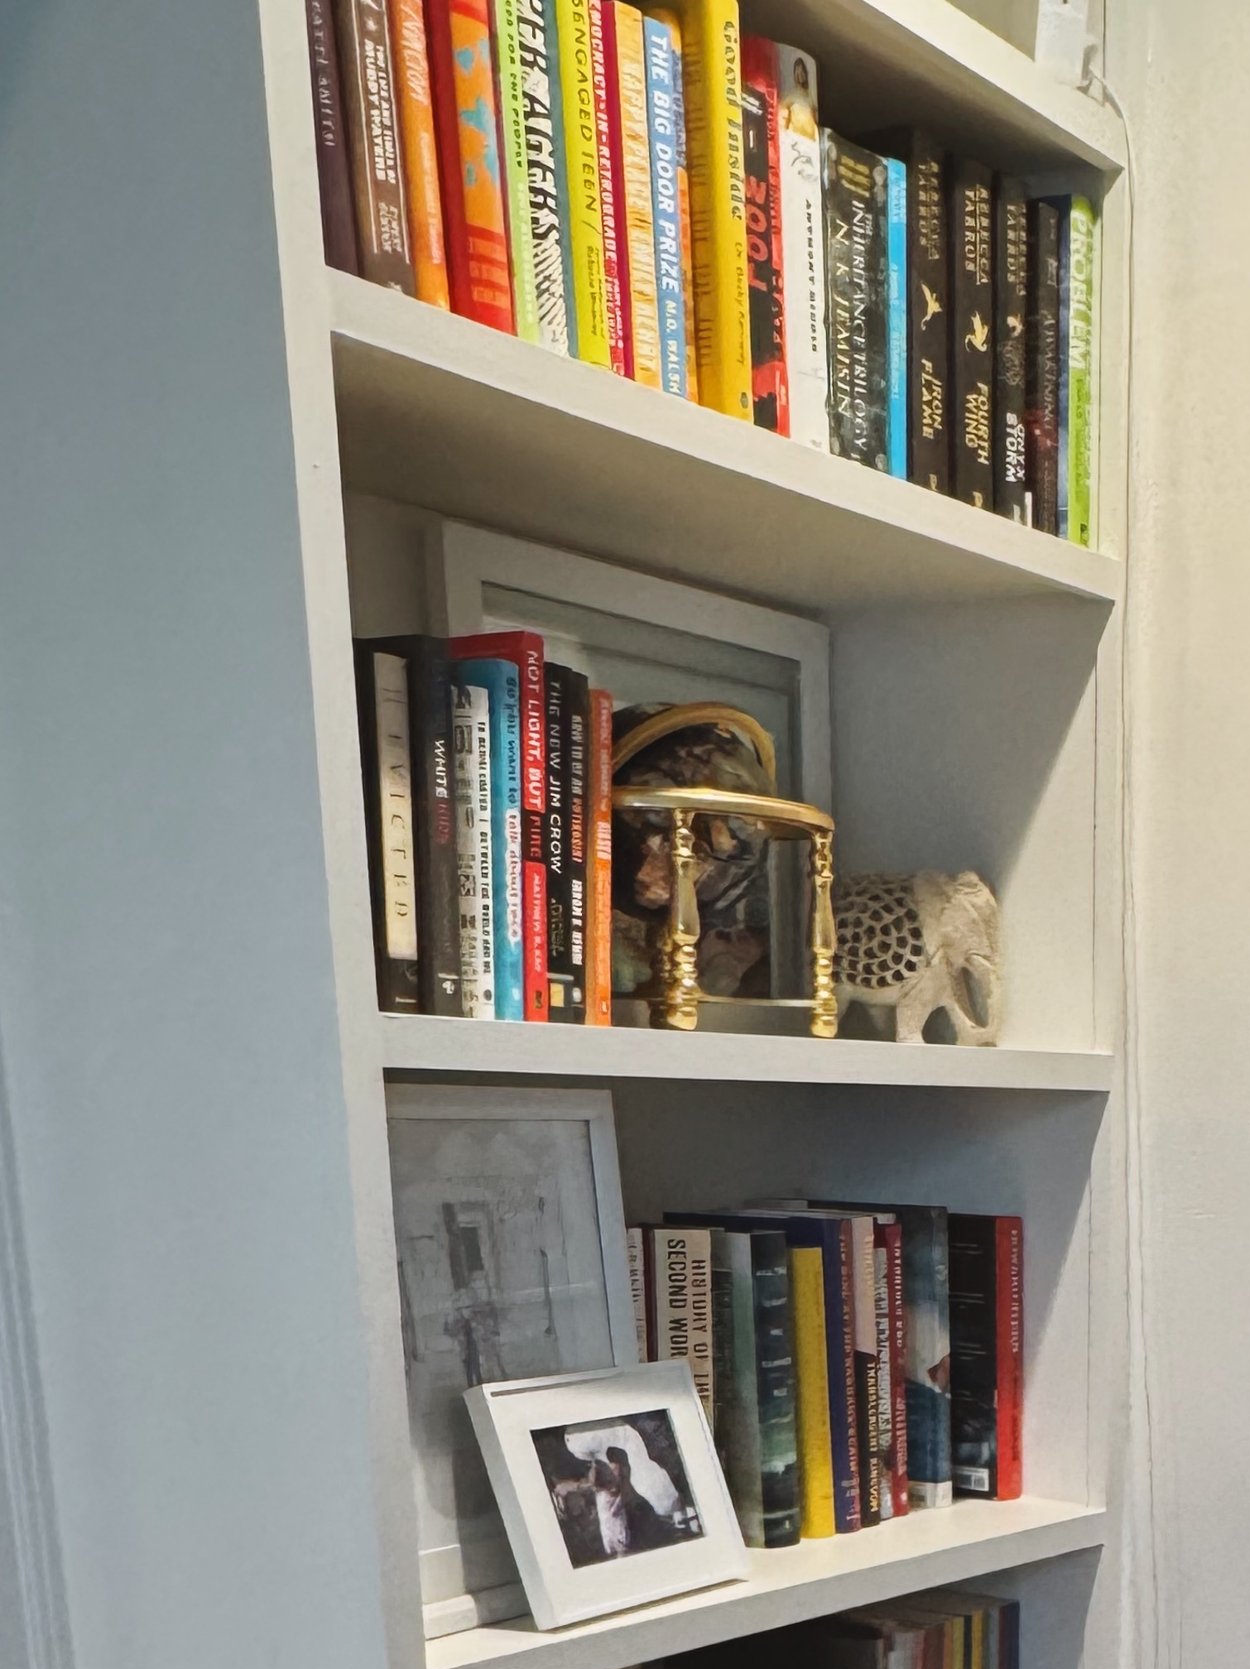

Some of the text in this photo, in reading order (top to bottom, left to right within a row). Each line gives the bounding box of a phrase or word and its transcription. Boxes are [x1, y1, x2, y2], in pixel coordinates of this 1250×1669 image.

[650, 35, 669, 84] THE
[653, 90, 672, 135] BIG
[581, 151, 597, 212] TEEN
[655, 143, 675, 213] DOOR
[658, 219, 680, 294] PRIZE
[1069, 209, 1090, 369] PROBLEM
[833, 293, 852, 418] JEMISIN
[851, 200, 870, 454] INHERITANCE TRILOGY
[667, 340, 683, 393] WALSH
[921, 358, 934, 440] FLAME
[930, 376, 943, 430] IRON
[976, 382, 990, 465] FOURTH
[1005, 412, 1018, 483] STORM
[527, 650, 540, 693] NOT
[527, 700, 543, 762] LIGHT,
[549, 724, 562, 770] NEW
[527, 767, 543, 810] BUT
[549, 775, 562, 809] JIM
[549, 814, 563, 874] CROW
[667, 1238, 688, 1309] SECOND
[691, 1259, 707, 1333] HISTORY
